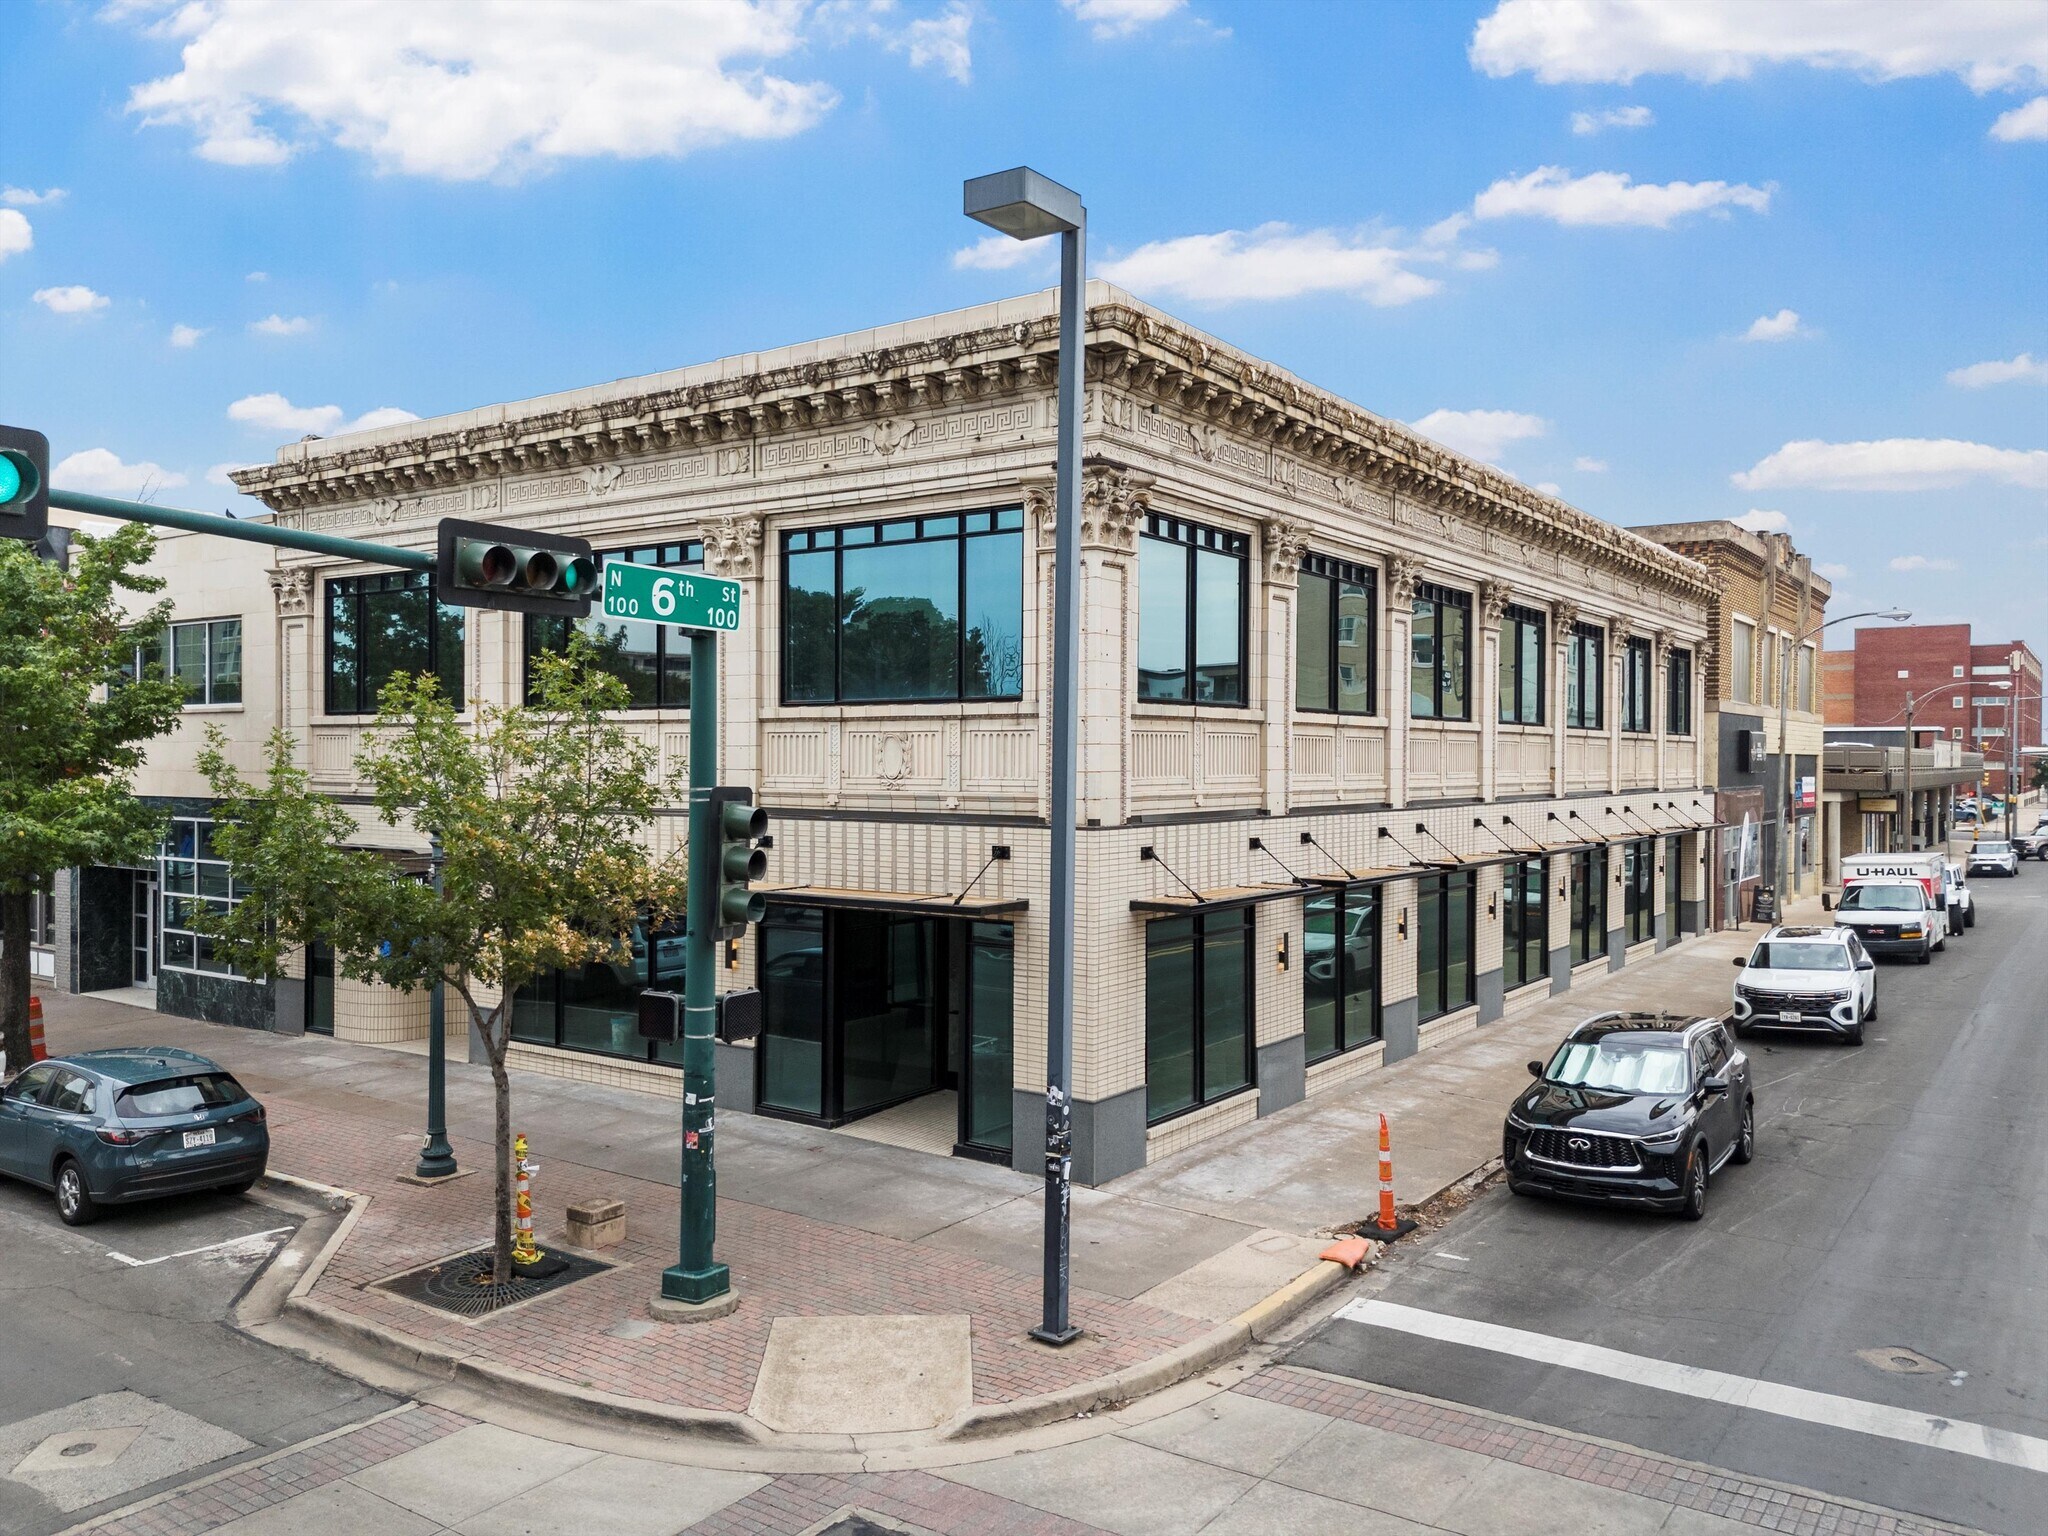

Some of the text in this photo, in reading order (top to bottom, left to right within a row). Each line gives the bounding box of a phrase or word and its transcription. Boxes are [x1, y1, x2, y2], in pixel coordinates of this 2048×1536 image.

[611, 570, 736, 616] N 6th St
[608, 596, 737, 628] 100 100
[1857, 867, 1918, 876] U-HAUL
